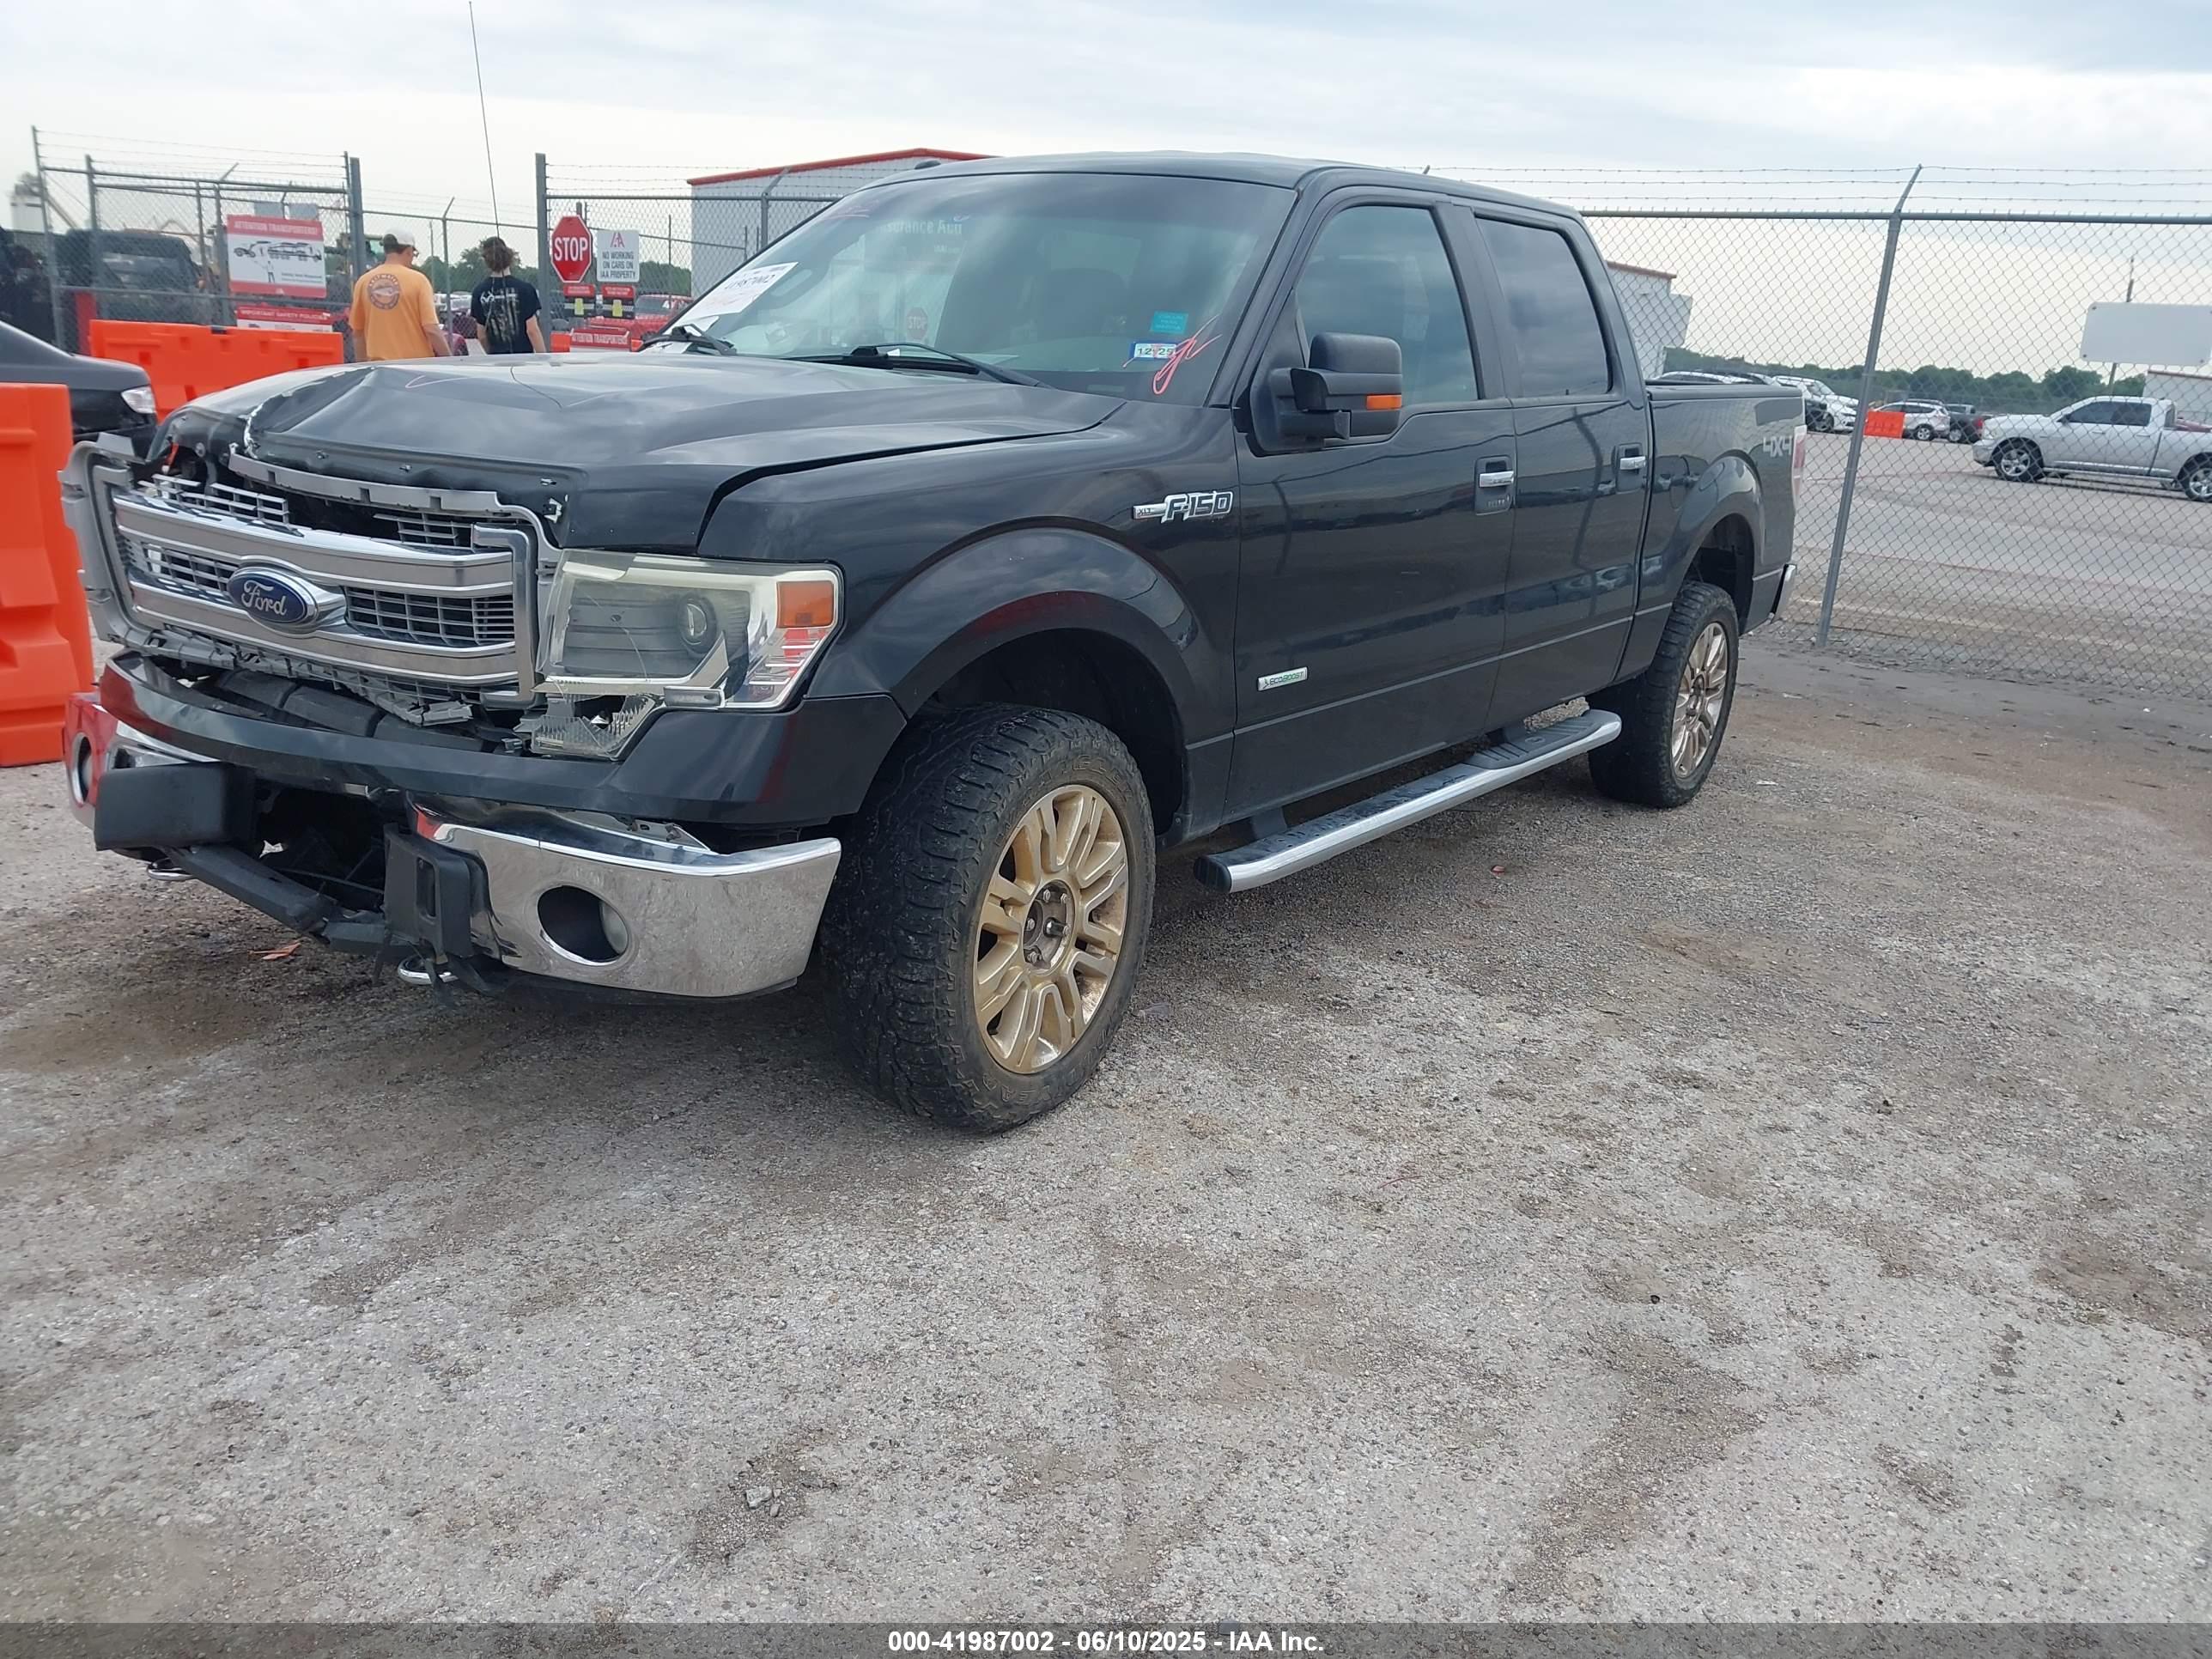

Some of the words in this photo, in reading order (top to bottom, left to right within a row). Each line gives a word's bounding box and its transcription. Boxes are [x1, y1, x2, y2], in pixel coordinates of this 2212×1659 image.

[554, 237, 588, 261] STOP
[603, 251, 610, 259] NO
[611, 251, 634, 259] WORKING
[611, 261, 624, 270] CARS
[611, 270, 635, 279] PROPERTY
[241, 580, 288, 616] Ford
